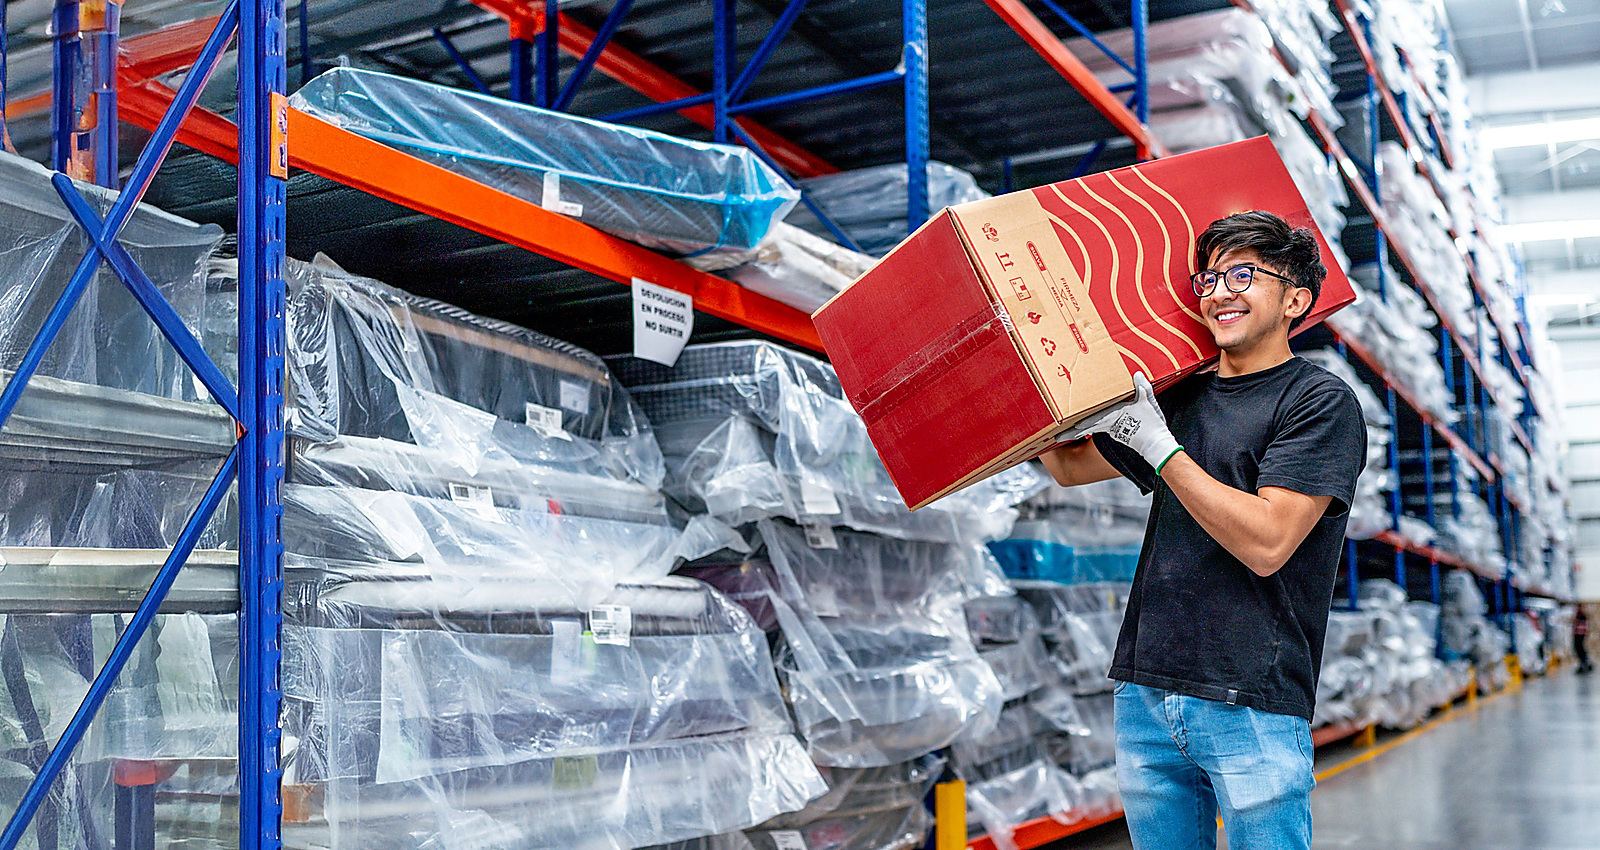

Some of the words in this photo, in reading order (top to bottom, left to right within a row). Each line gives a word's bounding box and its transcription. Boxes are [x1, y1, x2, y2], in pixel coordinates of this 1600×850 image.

[1030, 246, 1044, 268] SUAVE
[1051, 286, 1063, 308] MEDIA
[1072, 328, 1086, 349] FIRME
[1060, 277, 1080, 312] FIRMEZA
[641, 303, 652, 313] EN
[645, 320, 658, 331] NO
[659, 324, 683, 337] SURTIR
